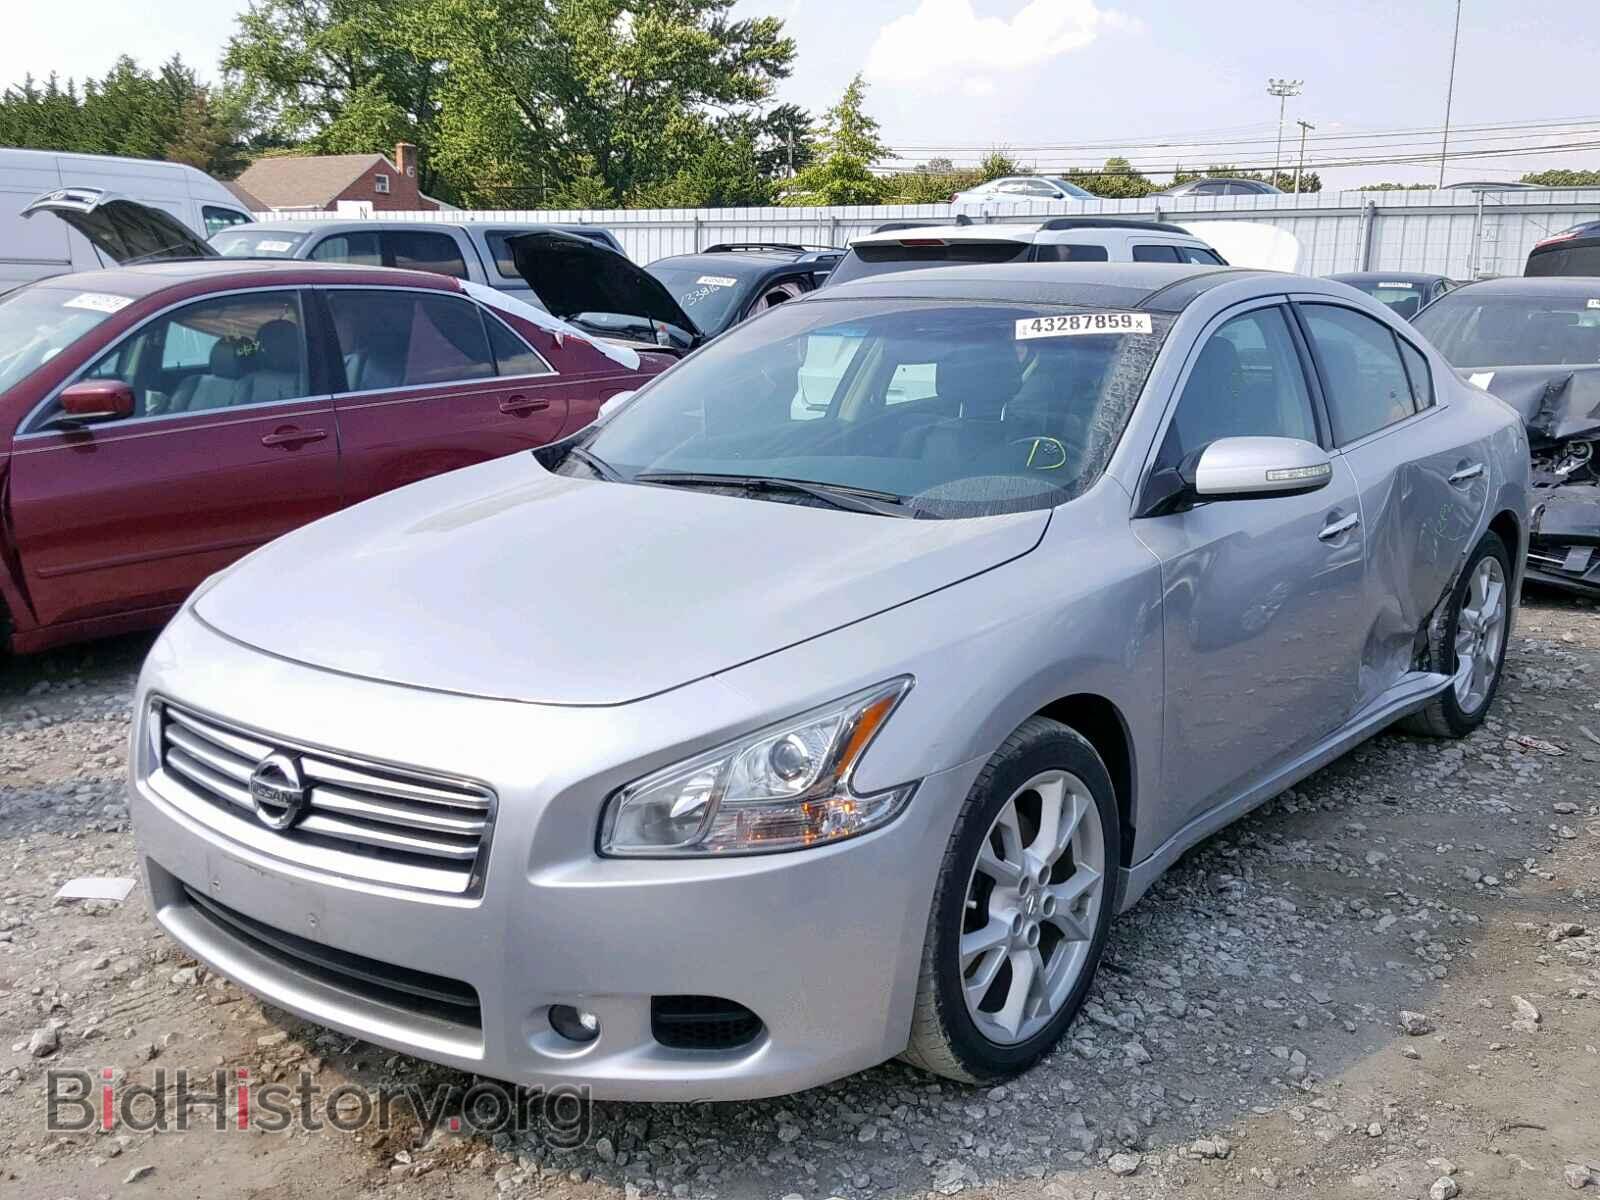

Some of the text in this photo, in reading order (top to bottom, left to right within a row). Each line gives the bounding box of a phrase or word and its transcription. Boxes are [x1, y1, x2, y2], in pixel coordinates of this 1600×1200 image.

[359, 206, 368, 220] N
[1030, 314, 1132, 332] 43287859
[251, 779, 293, 802] NISSAN
